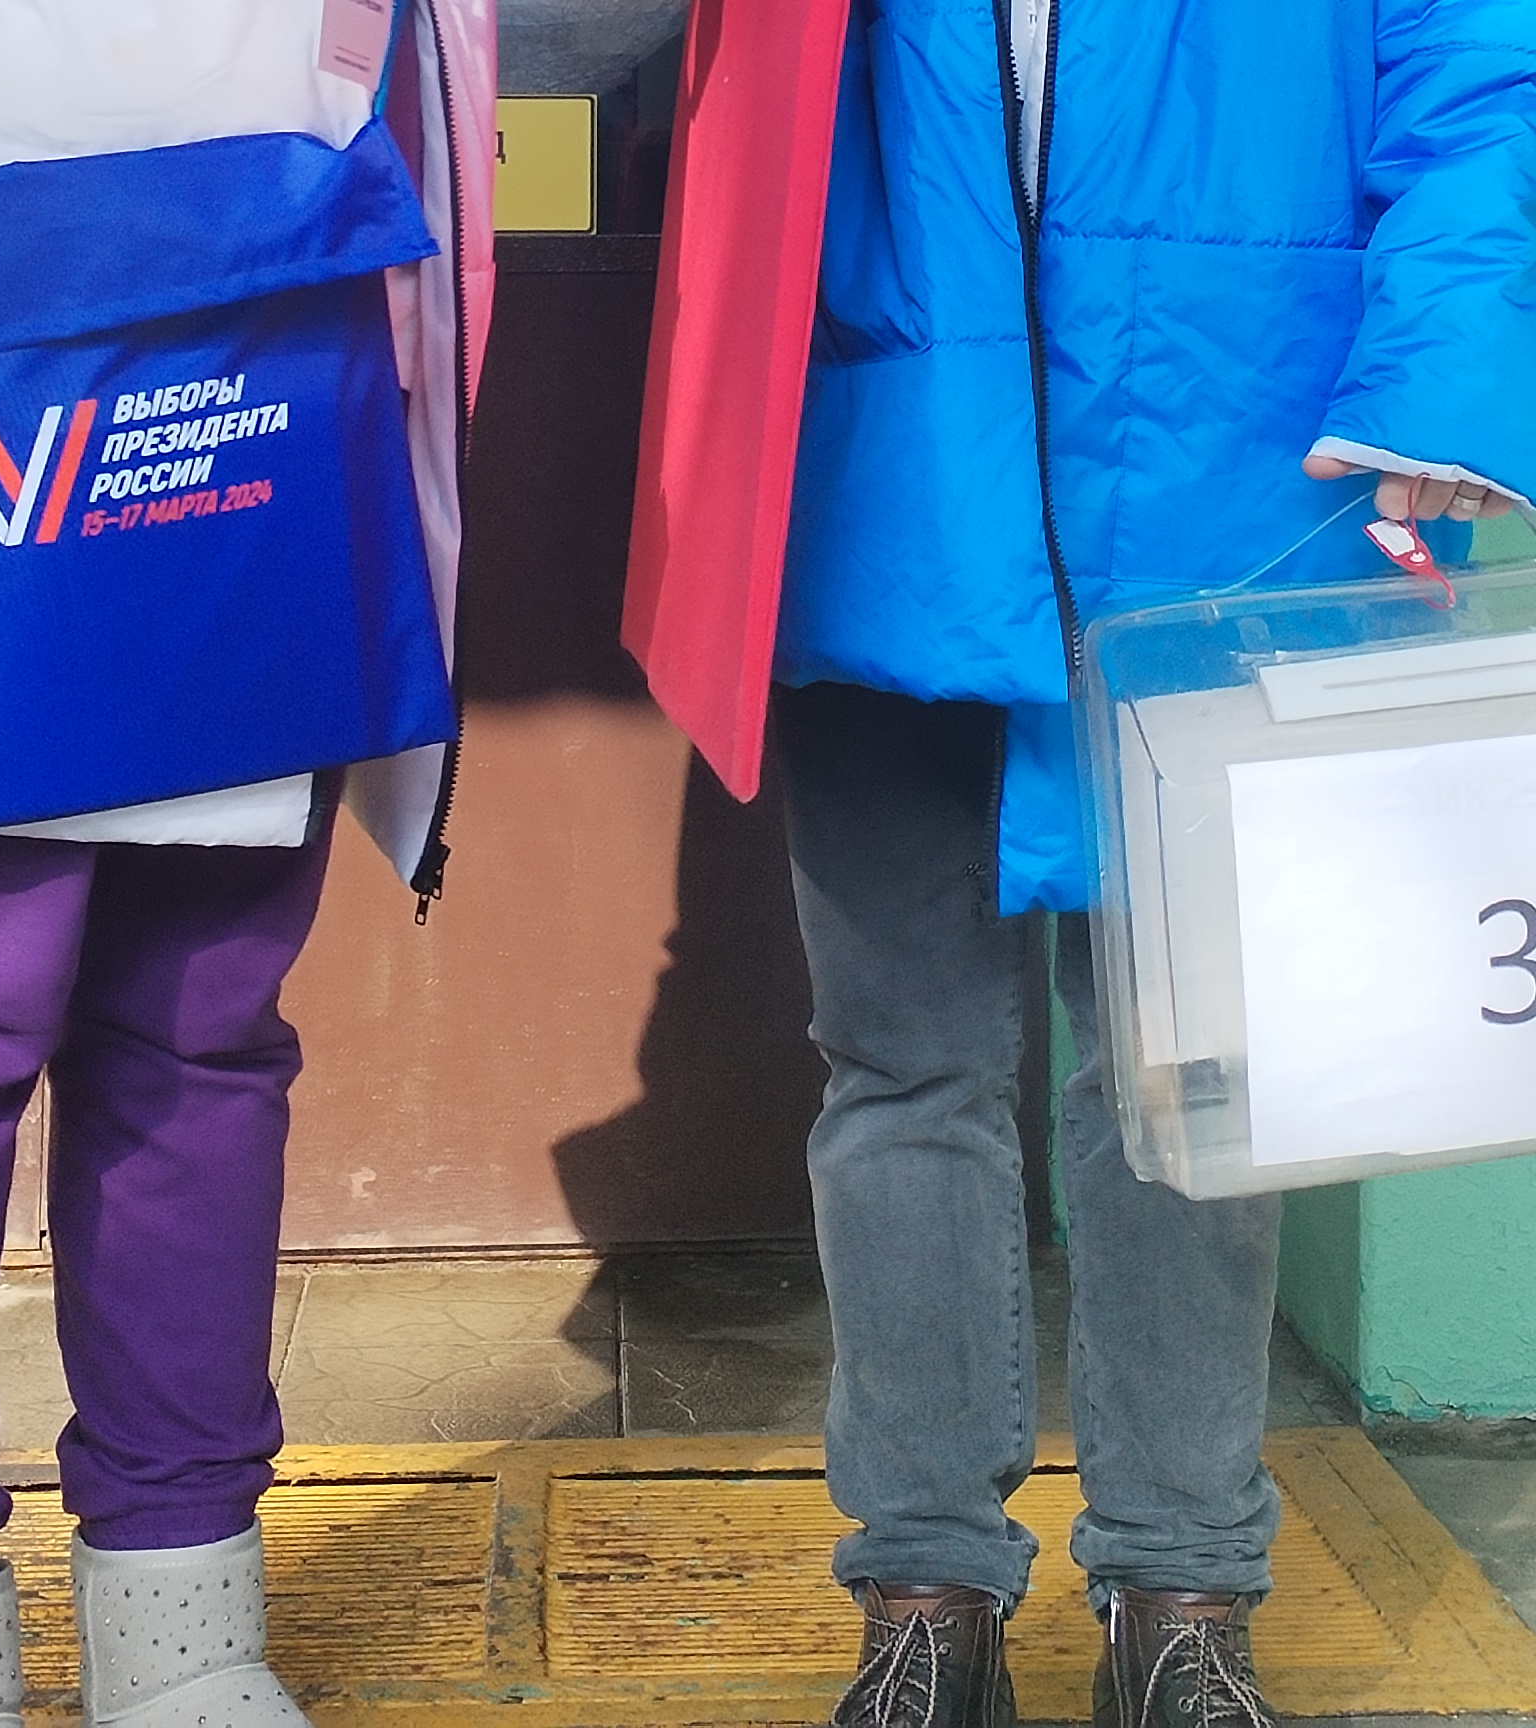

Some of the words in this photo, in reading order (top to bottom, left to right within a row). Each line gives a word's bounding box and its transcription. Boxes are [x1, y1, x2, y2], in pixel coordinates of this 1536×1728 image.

[112, 373, 245, 424] ВЫБОРЫ
[101, 403, 288, 464] ПРЕЗИДЕНТА
[89, 455, 214, 503] РОССИИ
[144, 489, 219, 526] МАРТА
[221, 479, 273, 512] 2024
